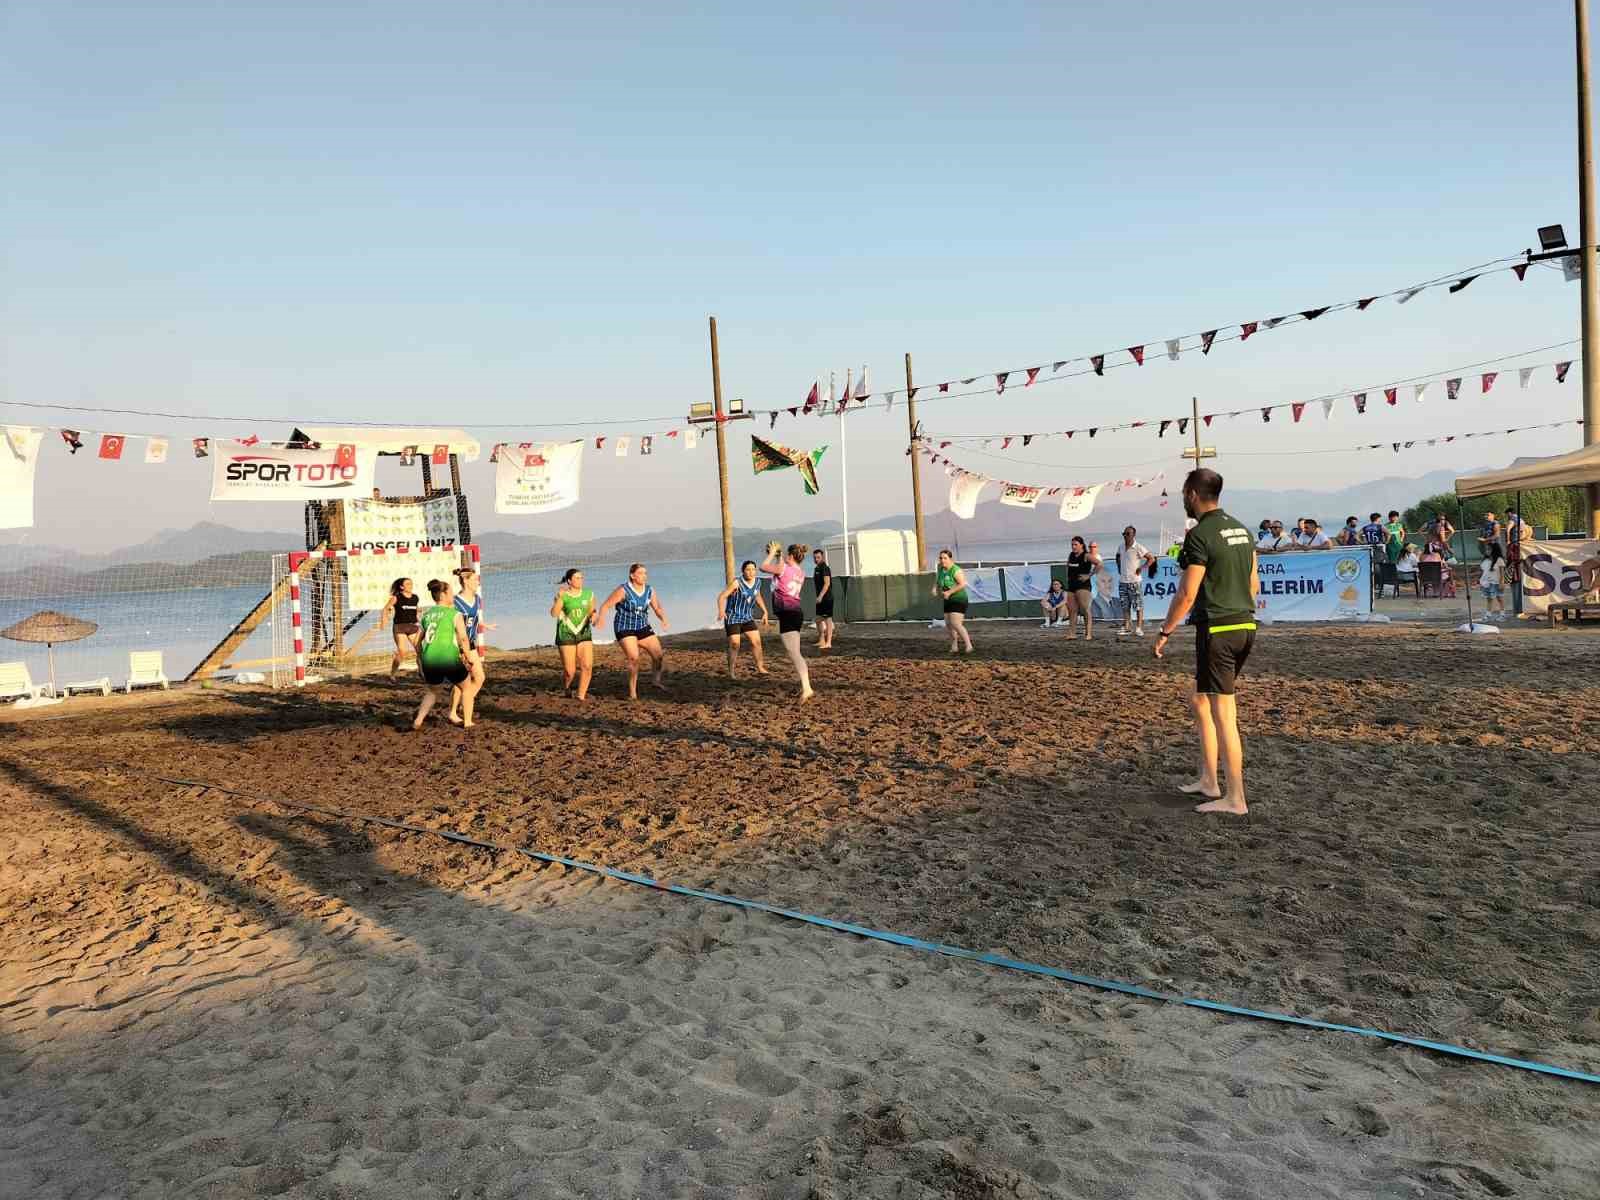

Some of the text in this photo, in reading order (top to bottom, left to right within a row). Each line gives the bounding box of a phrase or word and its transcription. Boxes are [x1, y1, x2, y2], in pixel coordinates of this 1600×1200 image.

[1257, 563, 1286, 576] ARA
[1143, 575, 1324, 599] AŞA LERİM
